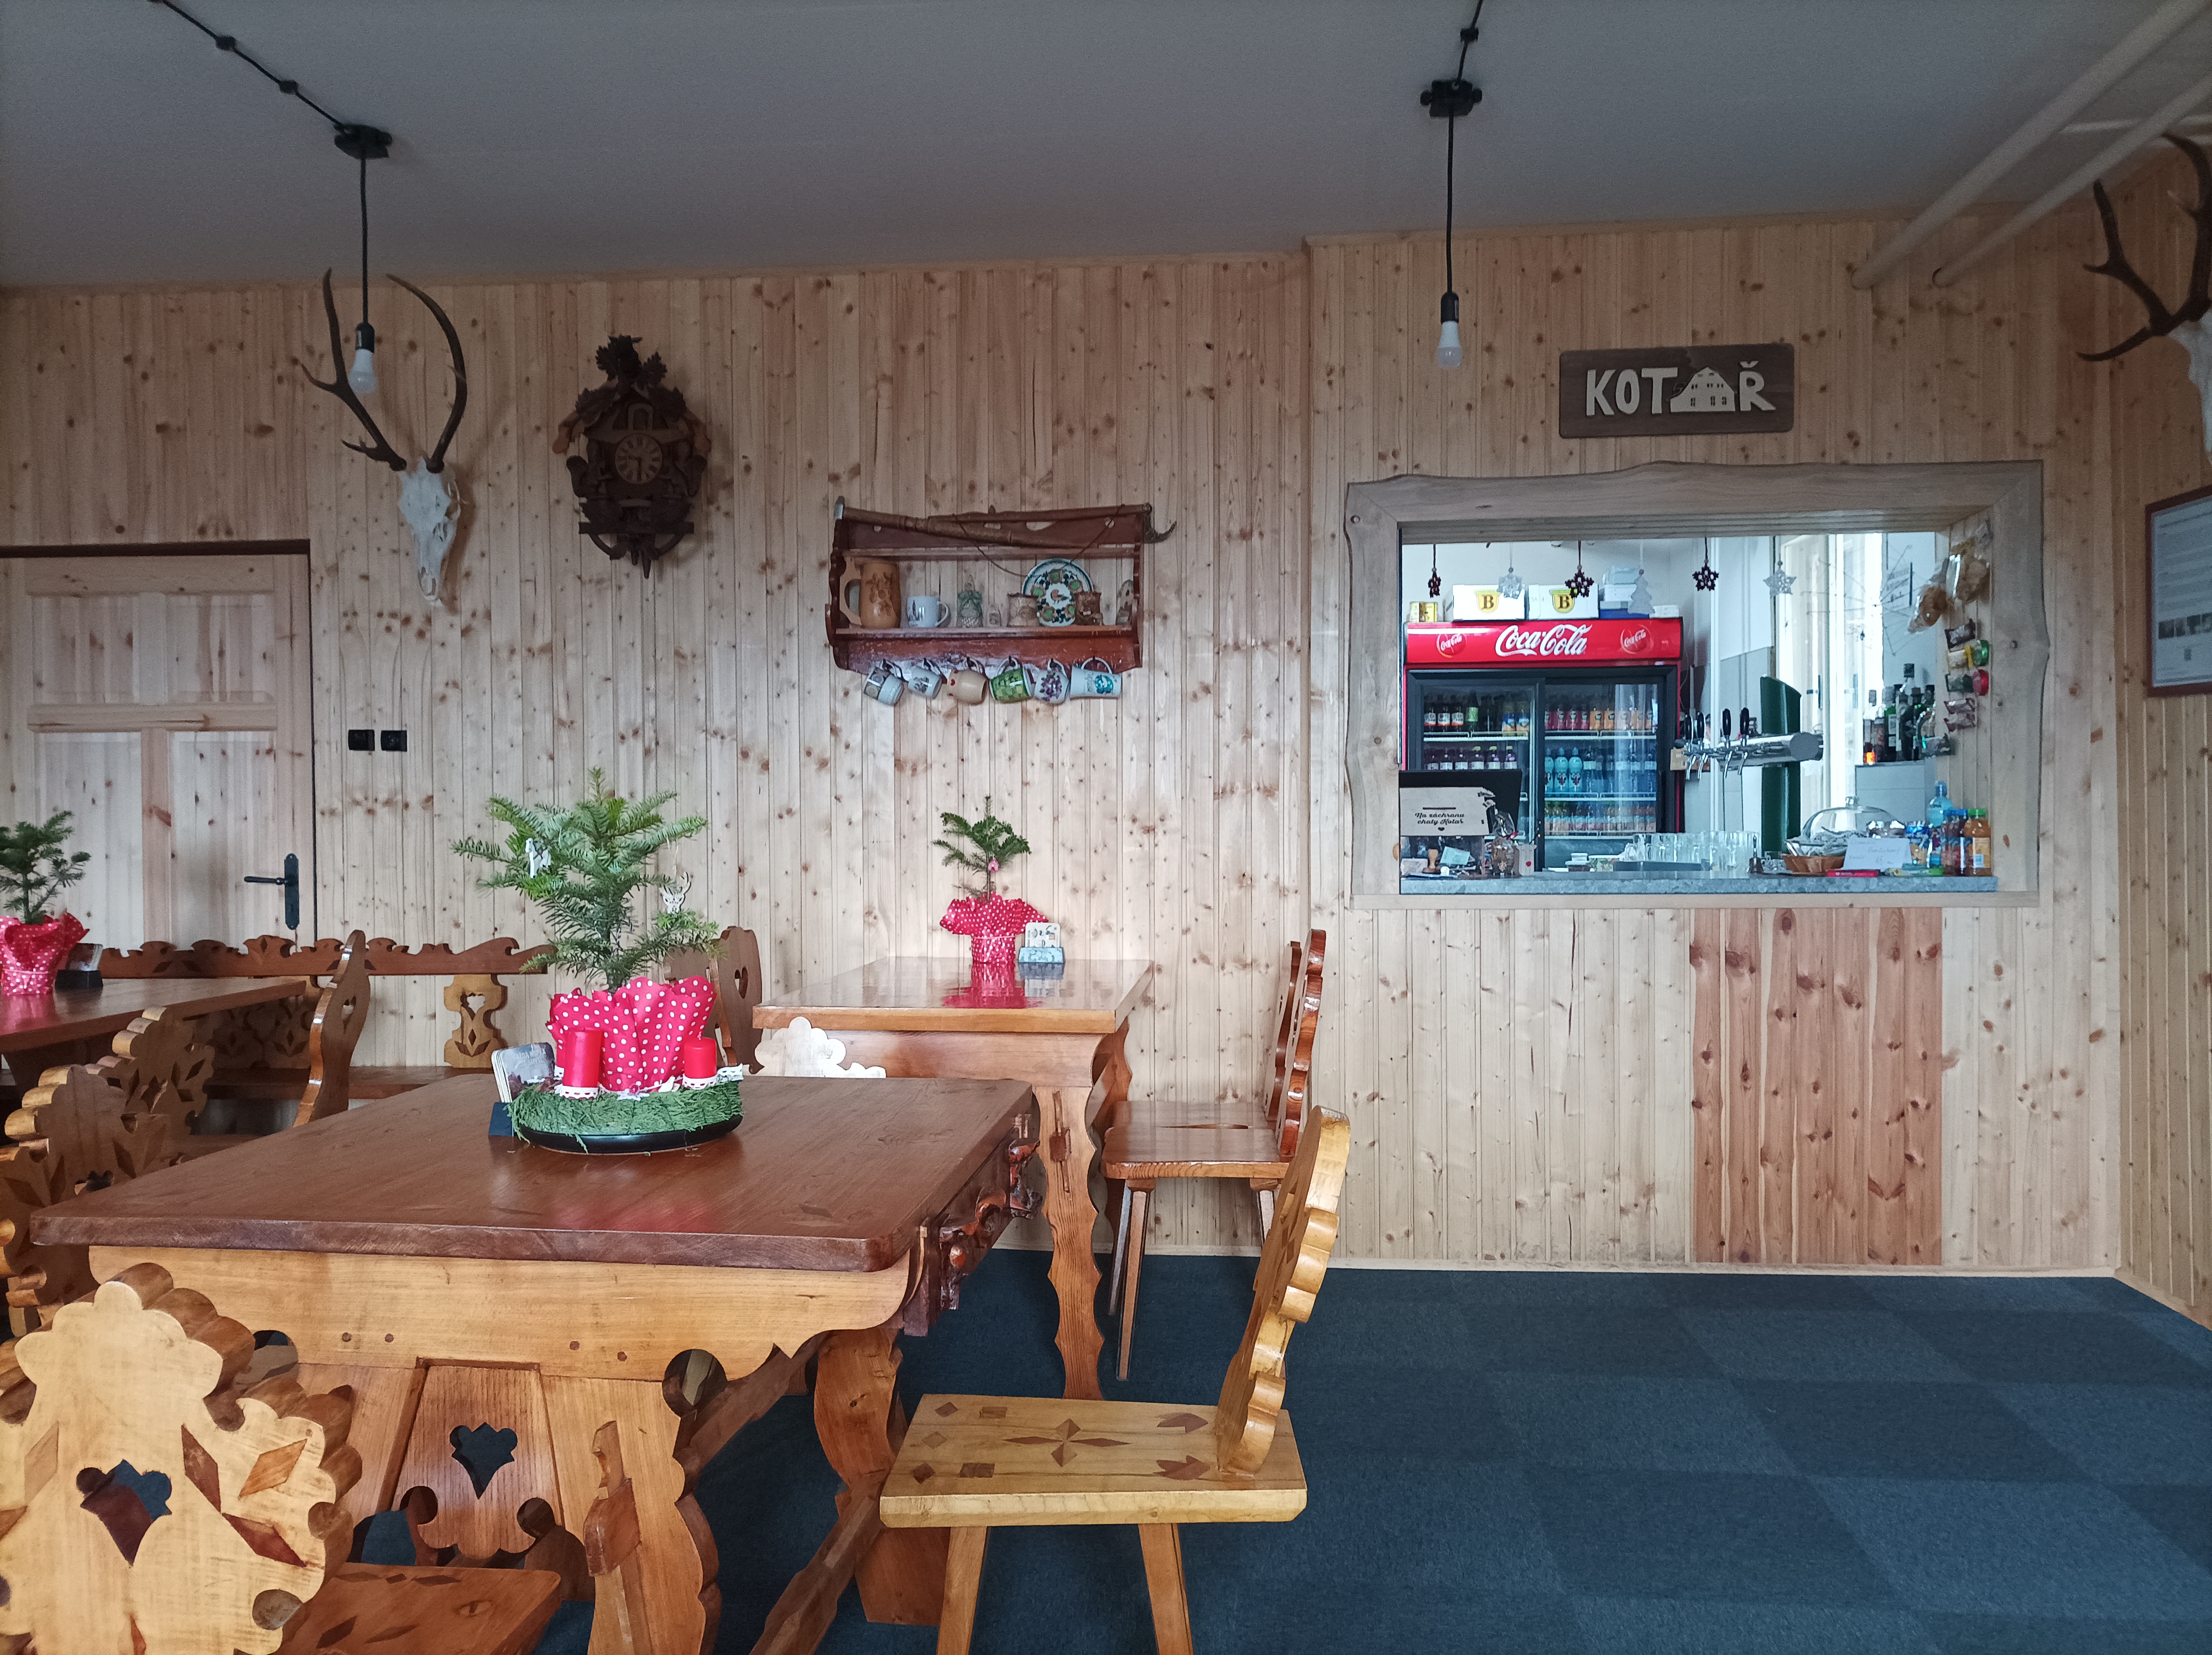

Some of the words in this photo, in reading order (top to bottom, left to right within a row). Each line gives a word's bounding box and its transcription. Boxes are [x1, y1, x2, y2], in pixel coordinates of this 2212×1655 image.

[1482, 594, 1494, 609] B
[1557, 594, 1571, 609] B
[1495, 624, 1593, 657] Coca-Cola
